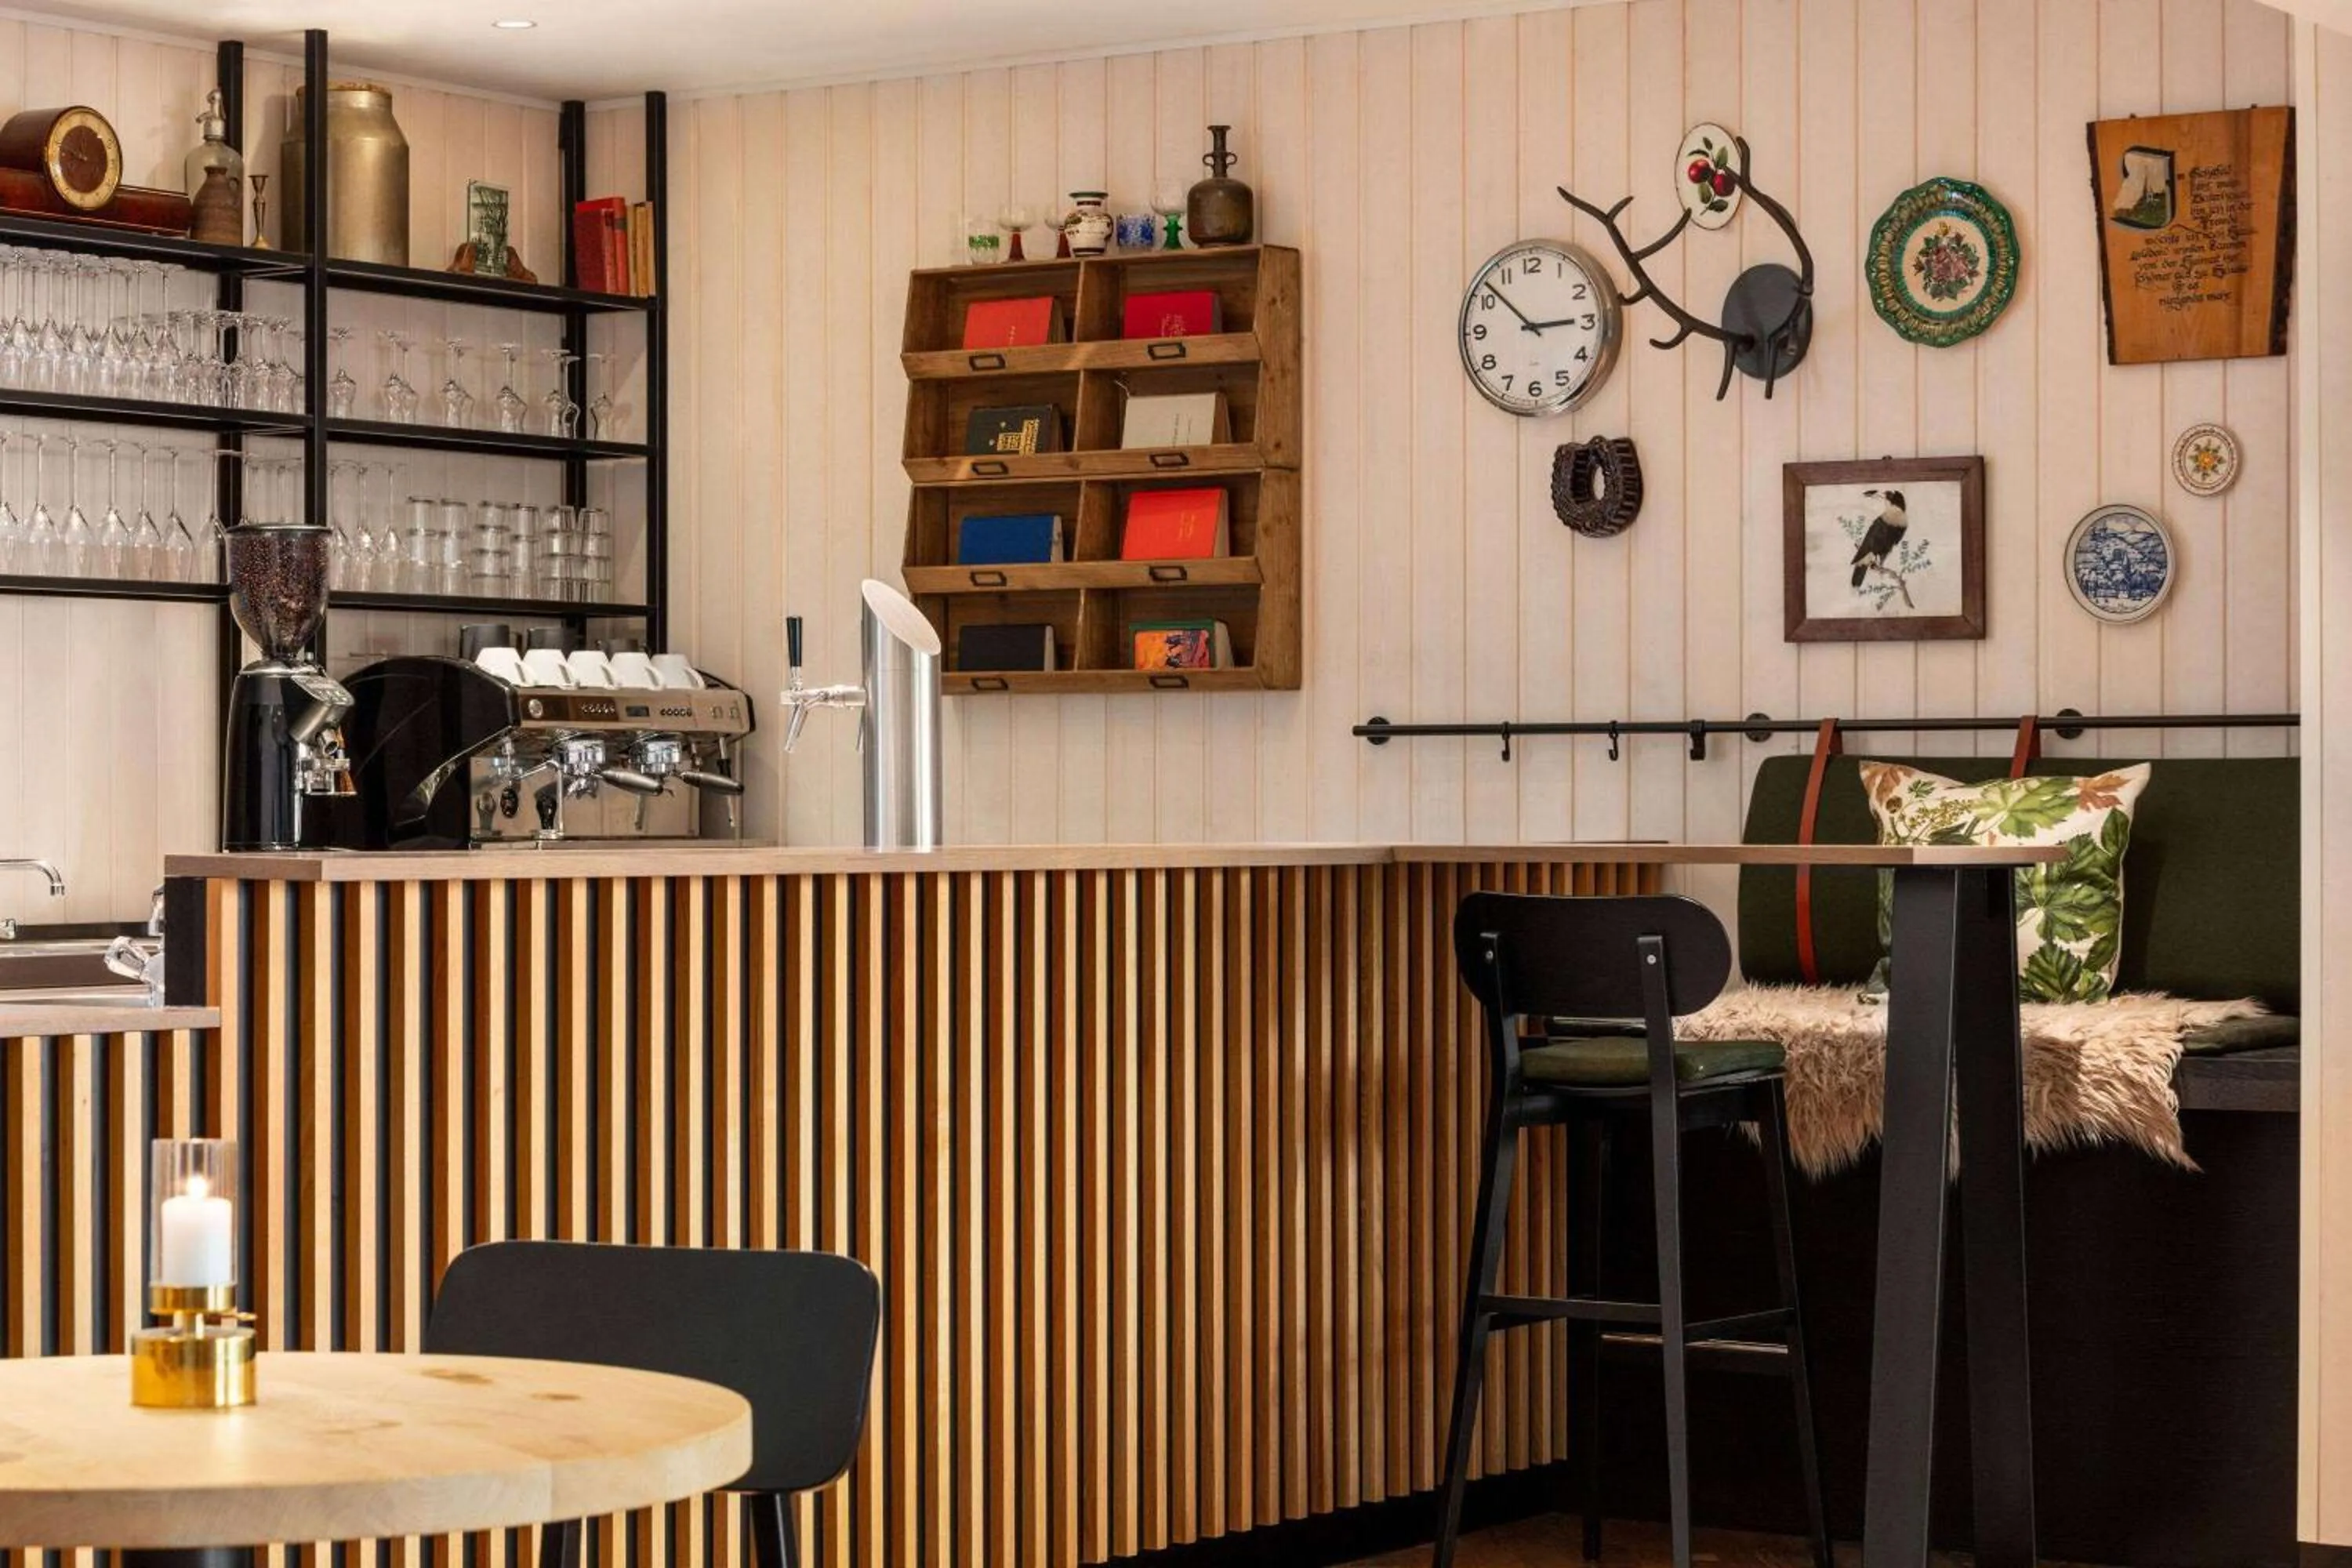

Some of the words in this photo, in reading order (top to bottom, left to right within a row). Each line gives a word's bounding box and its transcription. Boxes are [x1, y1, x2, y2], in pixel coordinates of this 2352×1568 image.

[1523, 257, 1541, 274] 12
[1557, 263, 1562, 278] 1
[1501, 267, 1512, 285] 11
[1572, 284, 1586, 299] 2
[1481, 294, 1495, 310] 10
[1581, 314, 1595, 330] 3
[1473, 325, 1487, 339] 9
[1482, 354, 1497, 369] 8
[1574, 346, 1588, 362] 4
[1501, 375, 1514, 391] 7
[1555, 370, 1570, 387] 5
[1528, 381, 1543, 397] 6
